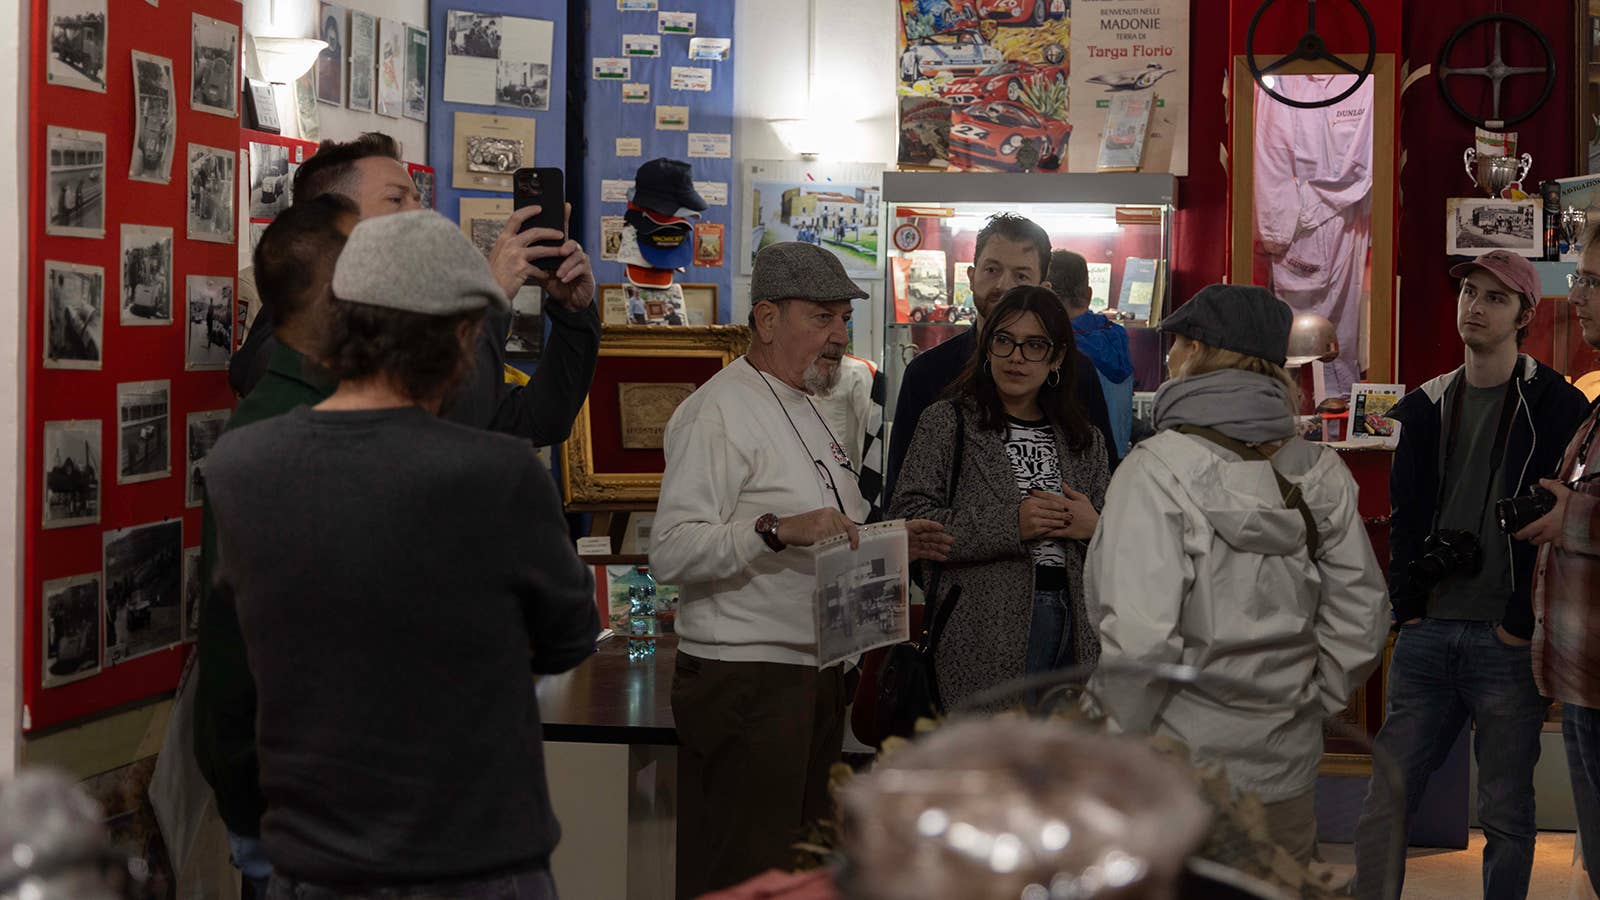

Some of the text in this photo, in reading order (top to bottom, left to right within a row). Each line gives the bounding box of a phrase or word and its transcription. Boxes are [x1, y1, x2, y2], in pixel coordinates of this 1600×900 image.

[1100, 18, 1161, 30] MADONIE
[1087, 45, 1173, 60] Targa Florio
